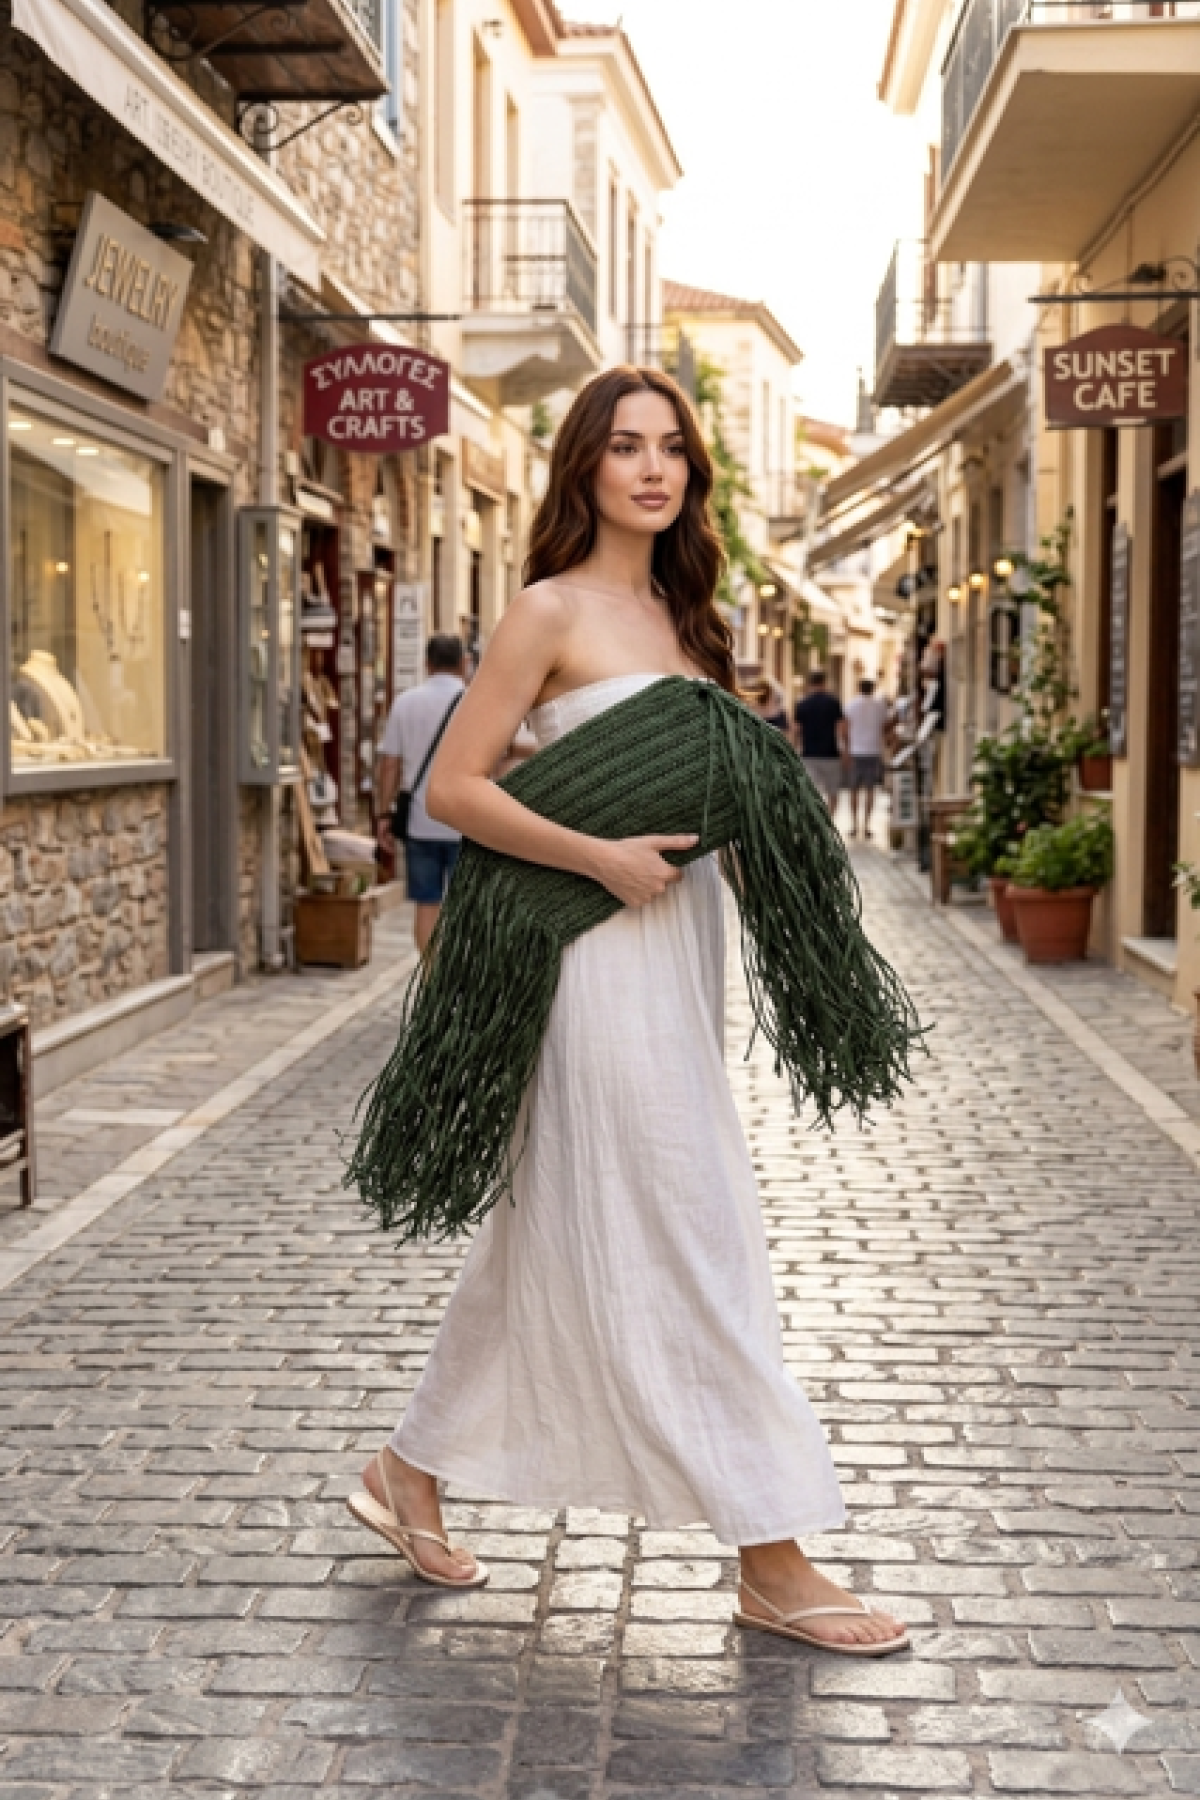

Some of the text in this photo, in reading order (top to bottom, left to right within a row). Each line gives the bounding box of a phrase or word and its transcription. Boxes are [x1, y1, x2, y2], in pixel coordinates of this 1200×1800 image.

[84, 232, 179, 332] JEWELRY
[310, 351, 442, 391] ΣΥΛΛΟΓΕΣ
[1053, 348, 1177, 381] SUNSET
[338, 388, 415, 412] ART &
[1072, 381, 1158, 411] CAFE
[327, 415, 426, 439] CRAFTS
